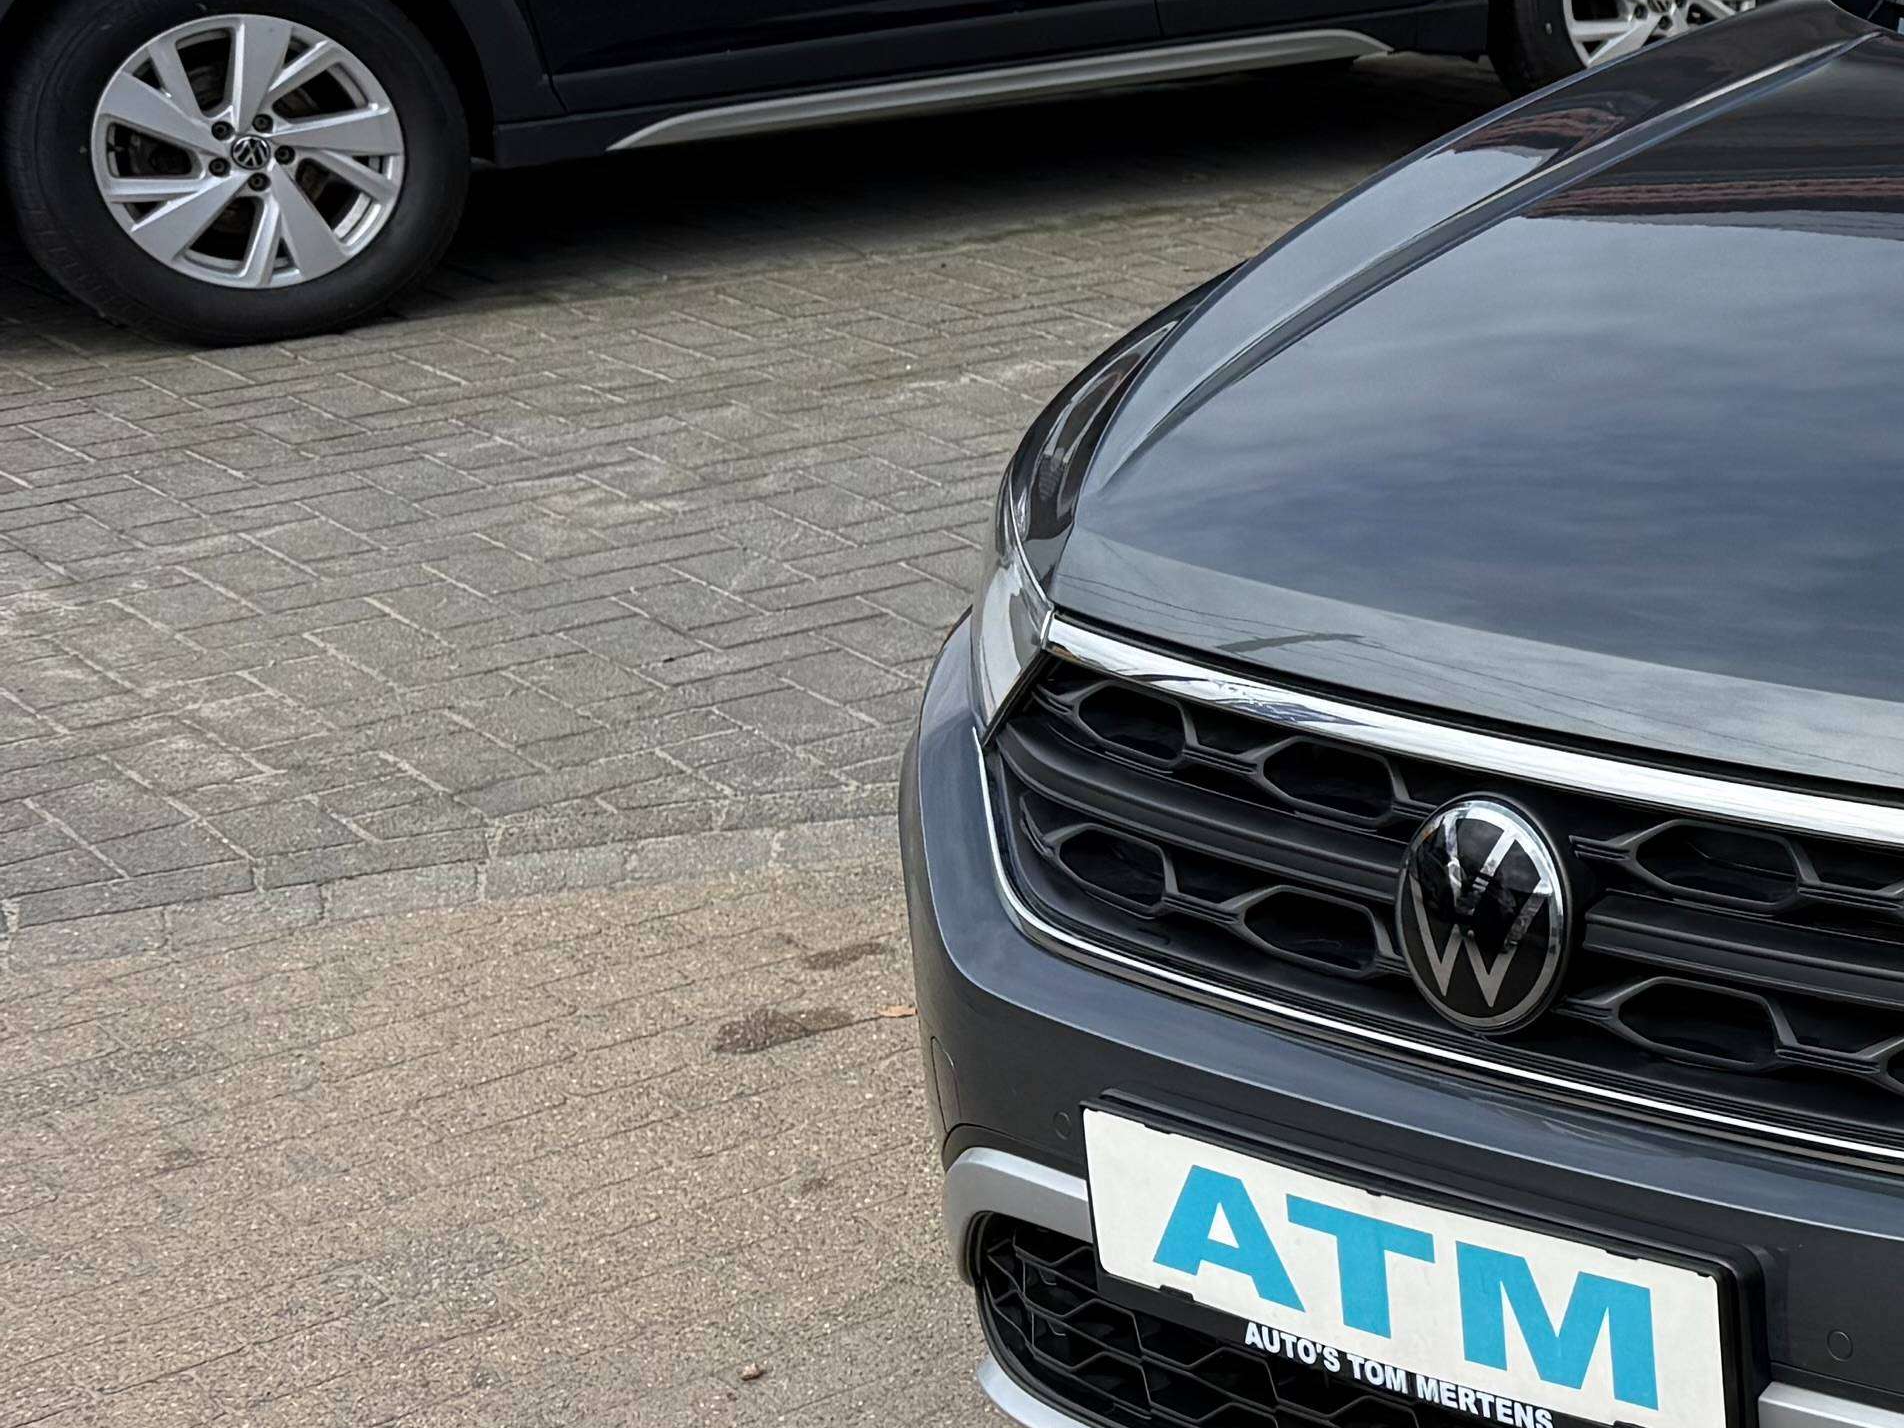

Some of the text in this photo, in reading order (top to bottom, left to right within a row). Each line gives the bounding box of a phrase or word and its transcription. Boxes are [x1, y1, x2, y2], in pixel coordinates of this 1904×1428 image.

[1153, 1165, 1659, 1411] ATM
[1245, 1322, 1341, 1373] AUTO'S
[1347, 1353, 1409, 1395] TOM
